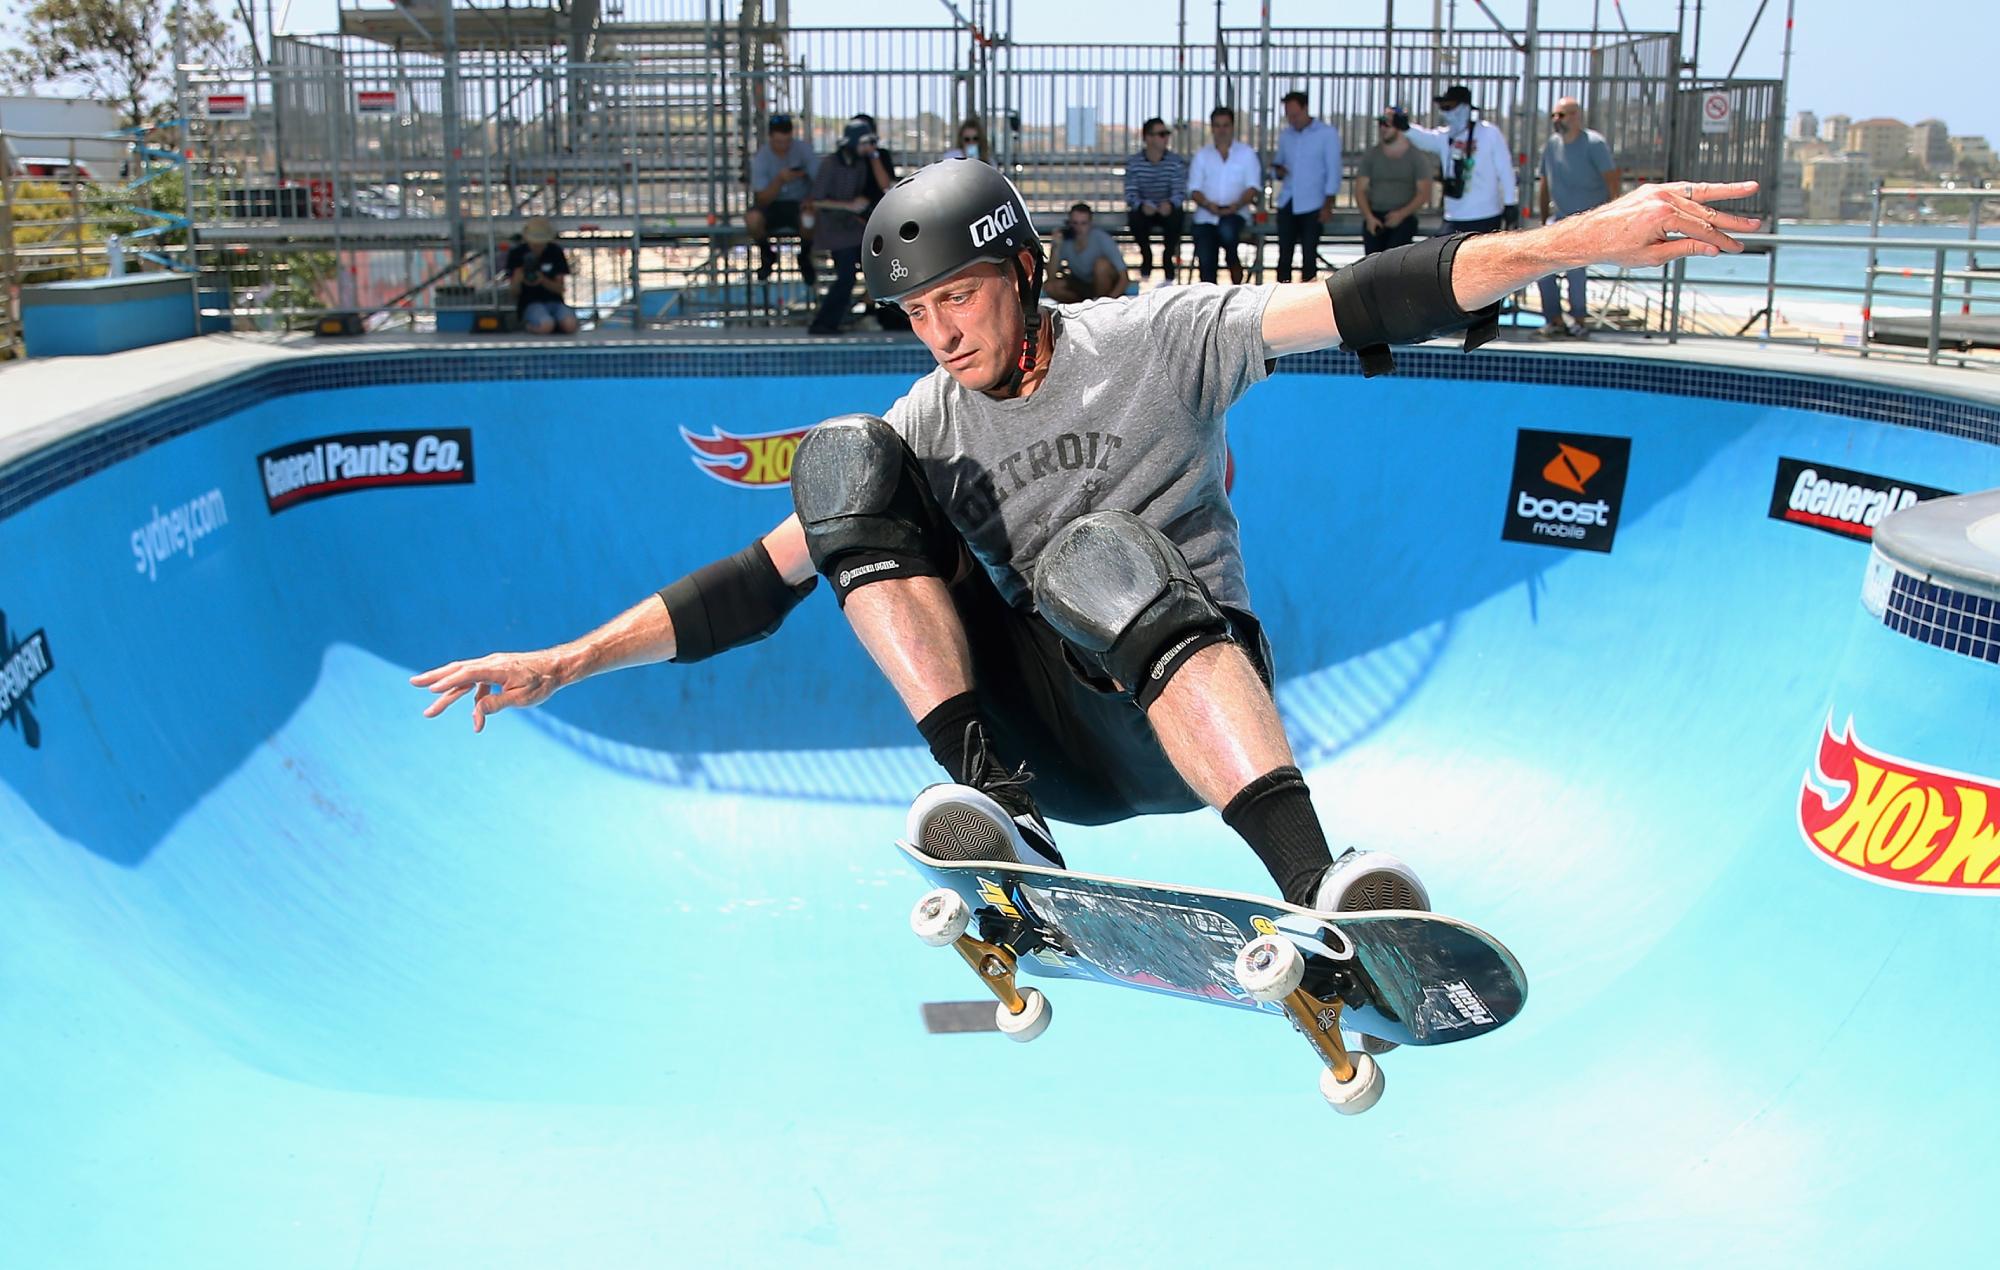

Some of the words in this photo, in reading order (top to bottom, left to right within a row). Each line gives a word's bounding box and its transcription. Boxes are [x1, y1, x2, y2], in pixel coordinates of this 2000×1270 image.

[264, 442, 326, 498] General
[325, 439, 409, 482] Pants
[412, 434, 464, 473] Co.
[740, 437, 801, 483] HO
[1516, 490, 1610, 527] boost
[1788, 468, 1901, 527] General
[131, 486, 229, 582] sydney.com
[1532, 521, 1586, 540] mobile
